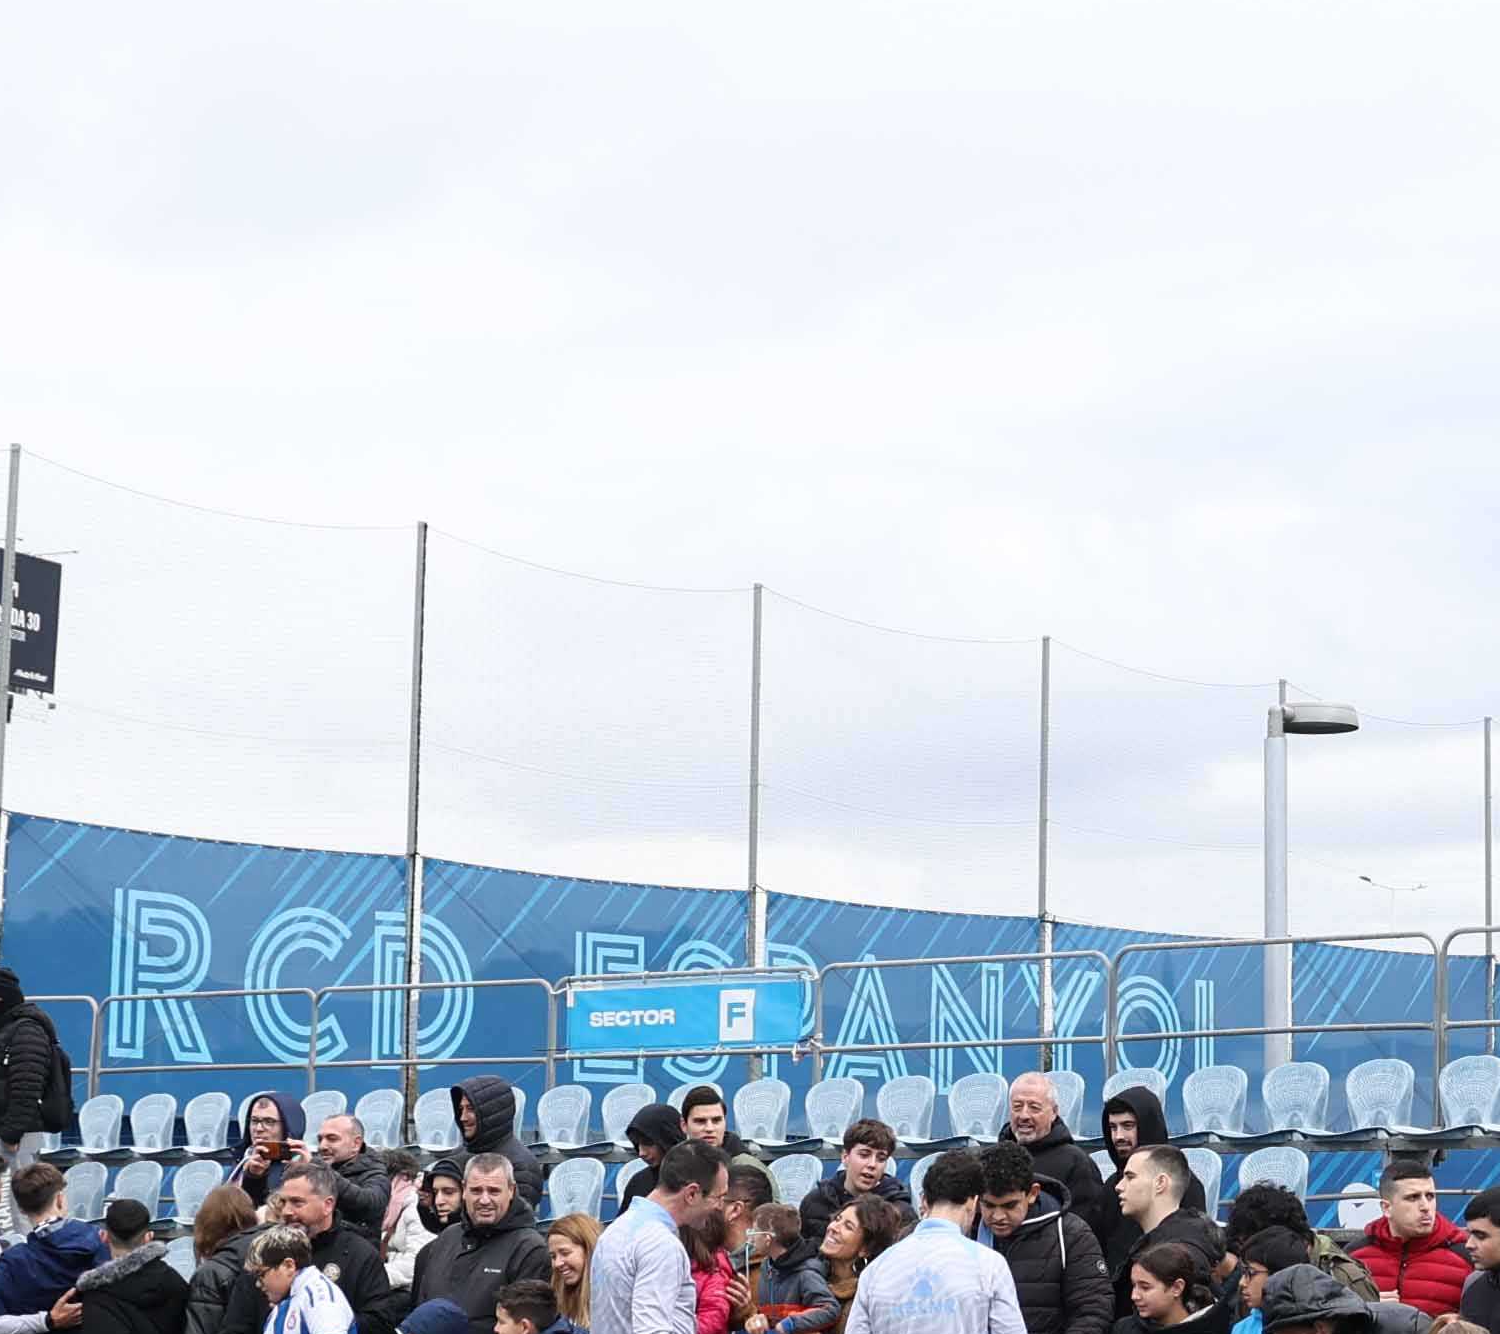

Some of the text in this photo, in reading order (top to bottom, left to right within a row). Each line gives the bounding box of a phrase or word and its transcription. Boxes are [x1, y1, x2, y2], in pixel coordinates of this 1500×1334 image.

[108, 887, 475, 1070] RCD
[589, 1001, 747, 1029] SECTOR F
